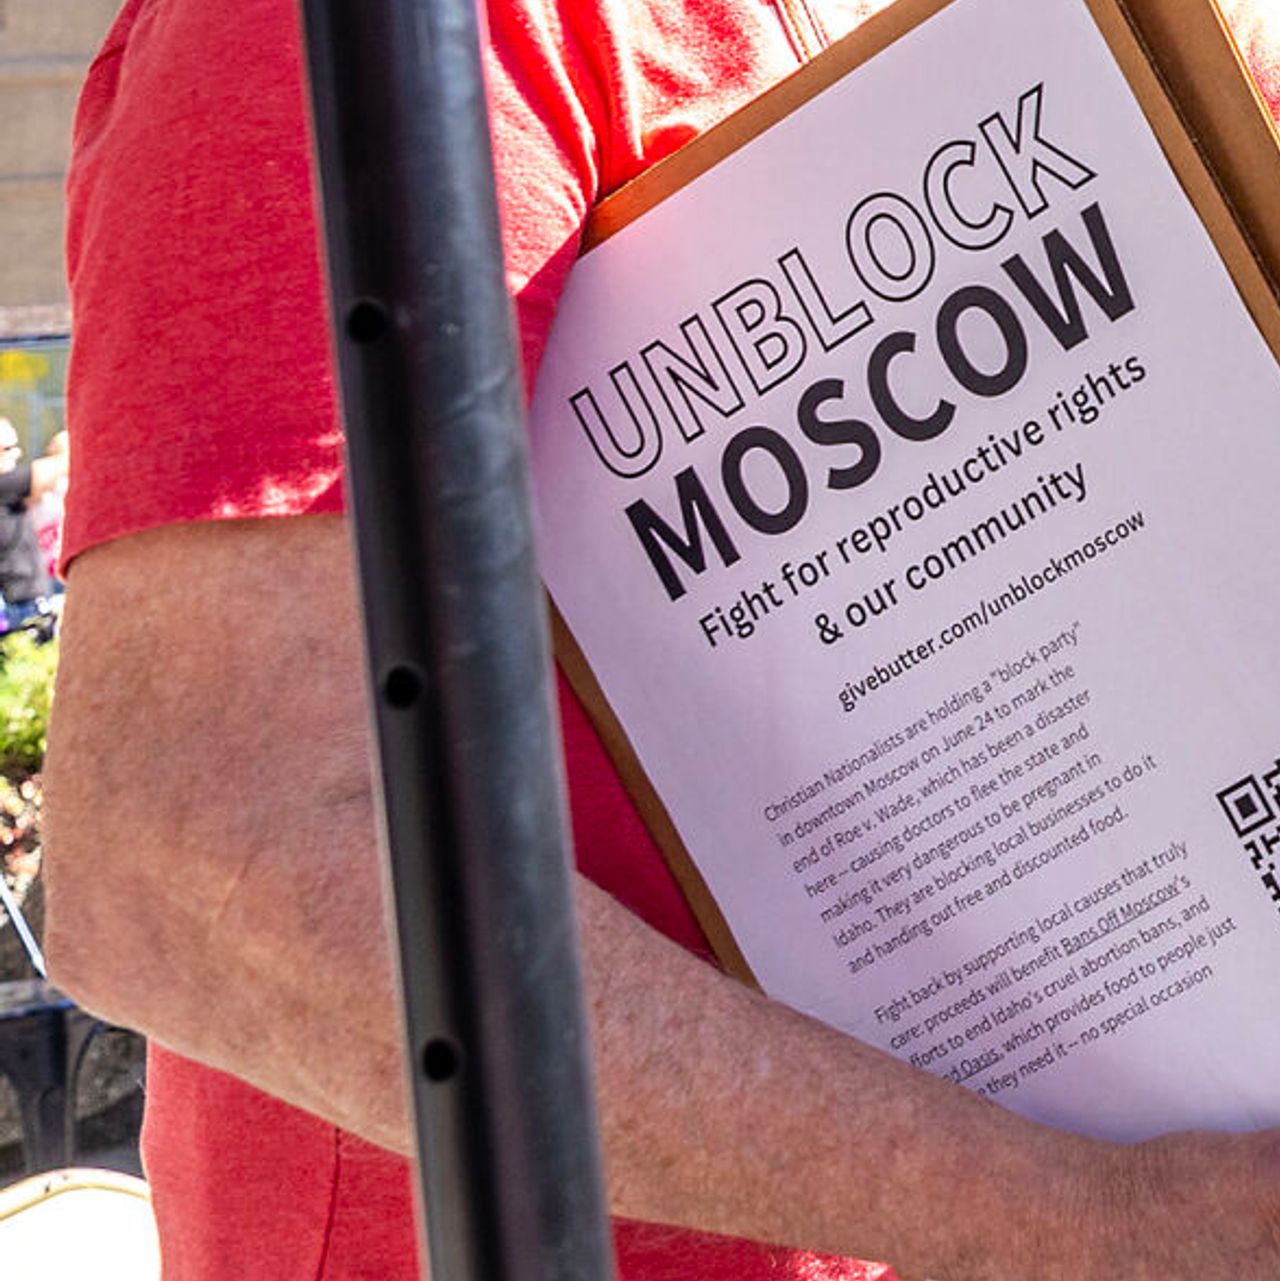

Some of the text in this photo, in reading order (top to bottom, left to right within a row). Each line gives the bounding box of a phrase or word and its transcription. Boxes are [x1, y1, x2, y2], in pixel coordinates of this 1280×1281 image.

[568, 82, 1097, 479] UNBLOCK
[624, 203, 1137, 601] MOSCOW
[698, 356, 1146, 647] Fight for reproductive rights
[814, 462, 1086, 644] & our community
[838, 511, 1144, 712] givebutter.com/unblockmoscow
[764, 779, 825, 822] Christian
[823, 732, 905, 786] Nationalists
[902, 718, 929, 740] are
[924, 685, 984, 724] holding
[776, 665, 1075, 846] in downtown Moscow on June 24 to mark the
[793, 845, 820, 873] end
[819, 835, 835, 857] of
[832, 824, 863, 847] Roe
[873, 793, 921, 823] Wade,
[917, 765, 962, 797] which
[958, 750, 988, 775] has
[984, 730, 1024, 758] been
[1034, 689, 1090, 730] disaster
[804, 873, 838, 898] here
[849, 834, 905, 873] causing
[901, 804, 955, 842] doctors
[953, 794, 971, 811] to
[969, 778, 999, 801] flee
[997, 763, 1024, 786] the
[1023, 743, 1061, 771] state
[1060, 721, 1089, 750] and
[820, 753, 1102, 923] making it very dangerous to be pregnant in
[832, 754, 1157, 948] Idaho. They are blocking local businesses to do it
[848, 803, 1128, 973] and handing out free and discounted food.
[873, 841, 1187, 1023] Fight back by supporting local causes that truly
[890, 874, 1190, 1049] care: proceeds will benefit Bans Off Moscow's
[946, 1034, 964, 1050] to
[965, 1013, 992, 1040] end
[989, 990, 1043, 1026] Idaho's
[1043, 965, 1080, 997] cruel
[1080, 937, 1141, 977] abortion
[1137, 915, 1182, 943] bans,
[1179, 894, 1210, 921] and
[960, 1047, 1004, 1079] Oasis,
[1001, 1020, 1046, 1052] which
[1044, 989, 1105, 1035] provides
[1102, 966, 1139, 997] food
[1137, 962, 1156, 978] to
[1156, 933, 1207, 972] people
[1204, 916, 1236, 946] just
[986, 1070, 1018, 1093] they
[1018, 1046, 1054, 1077] need
[1052, 1042, 1067, 1058] it
[1079, 1026, 1099, 1044] no
[1099, 995, 1150, 1035] special
[1149, 965, 1213, 1006] occasion
